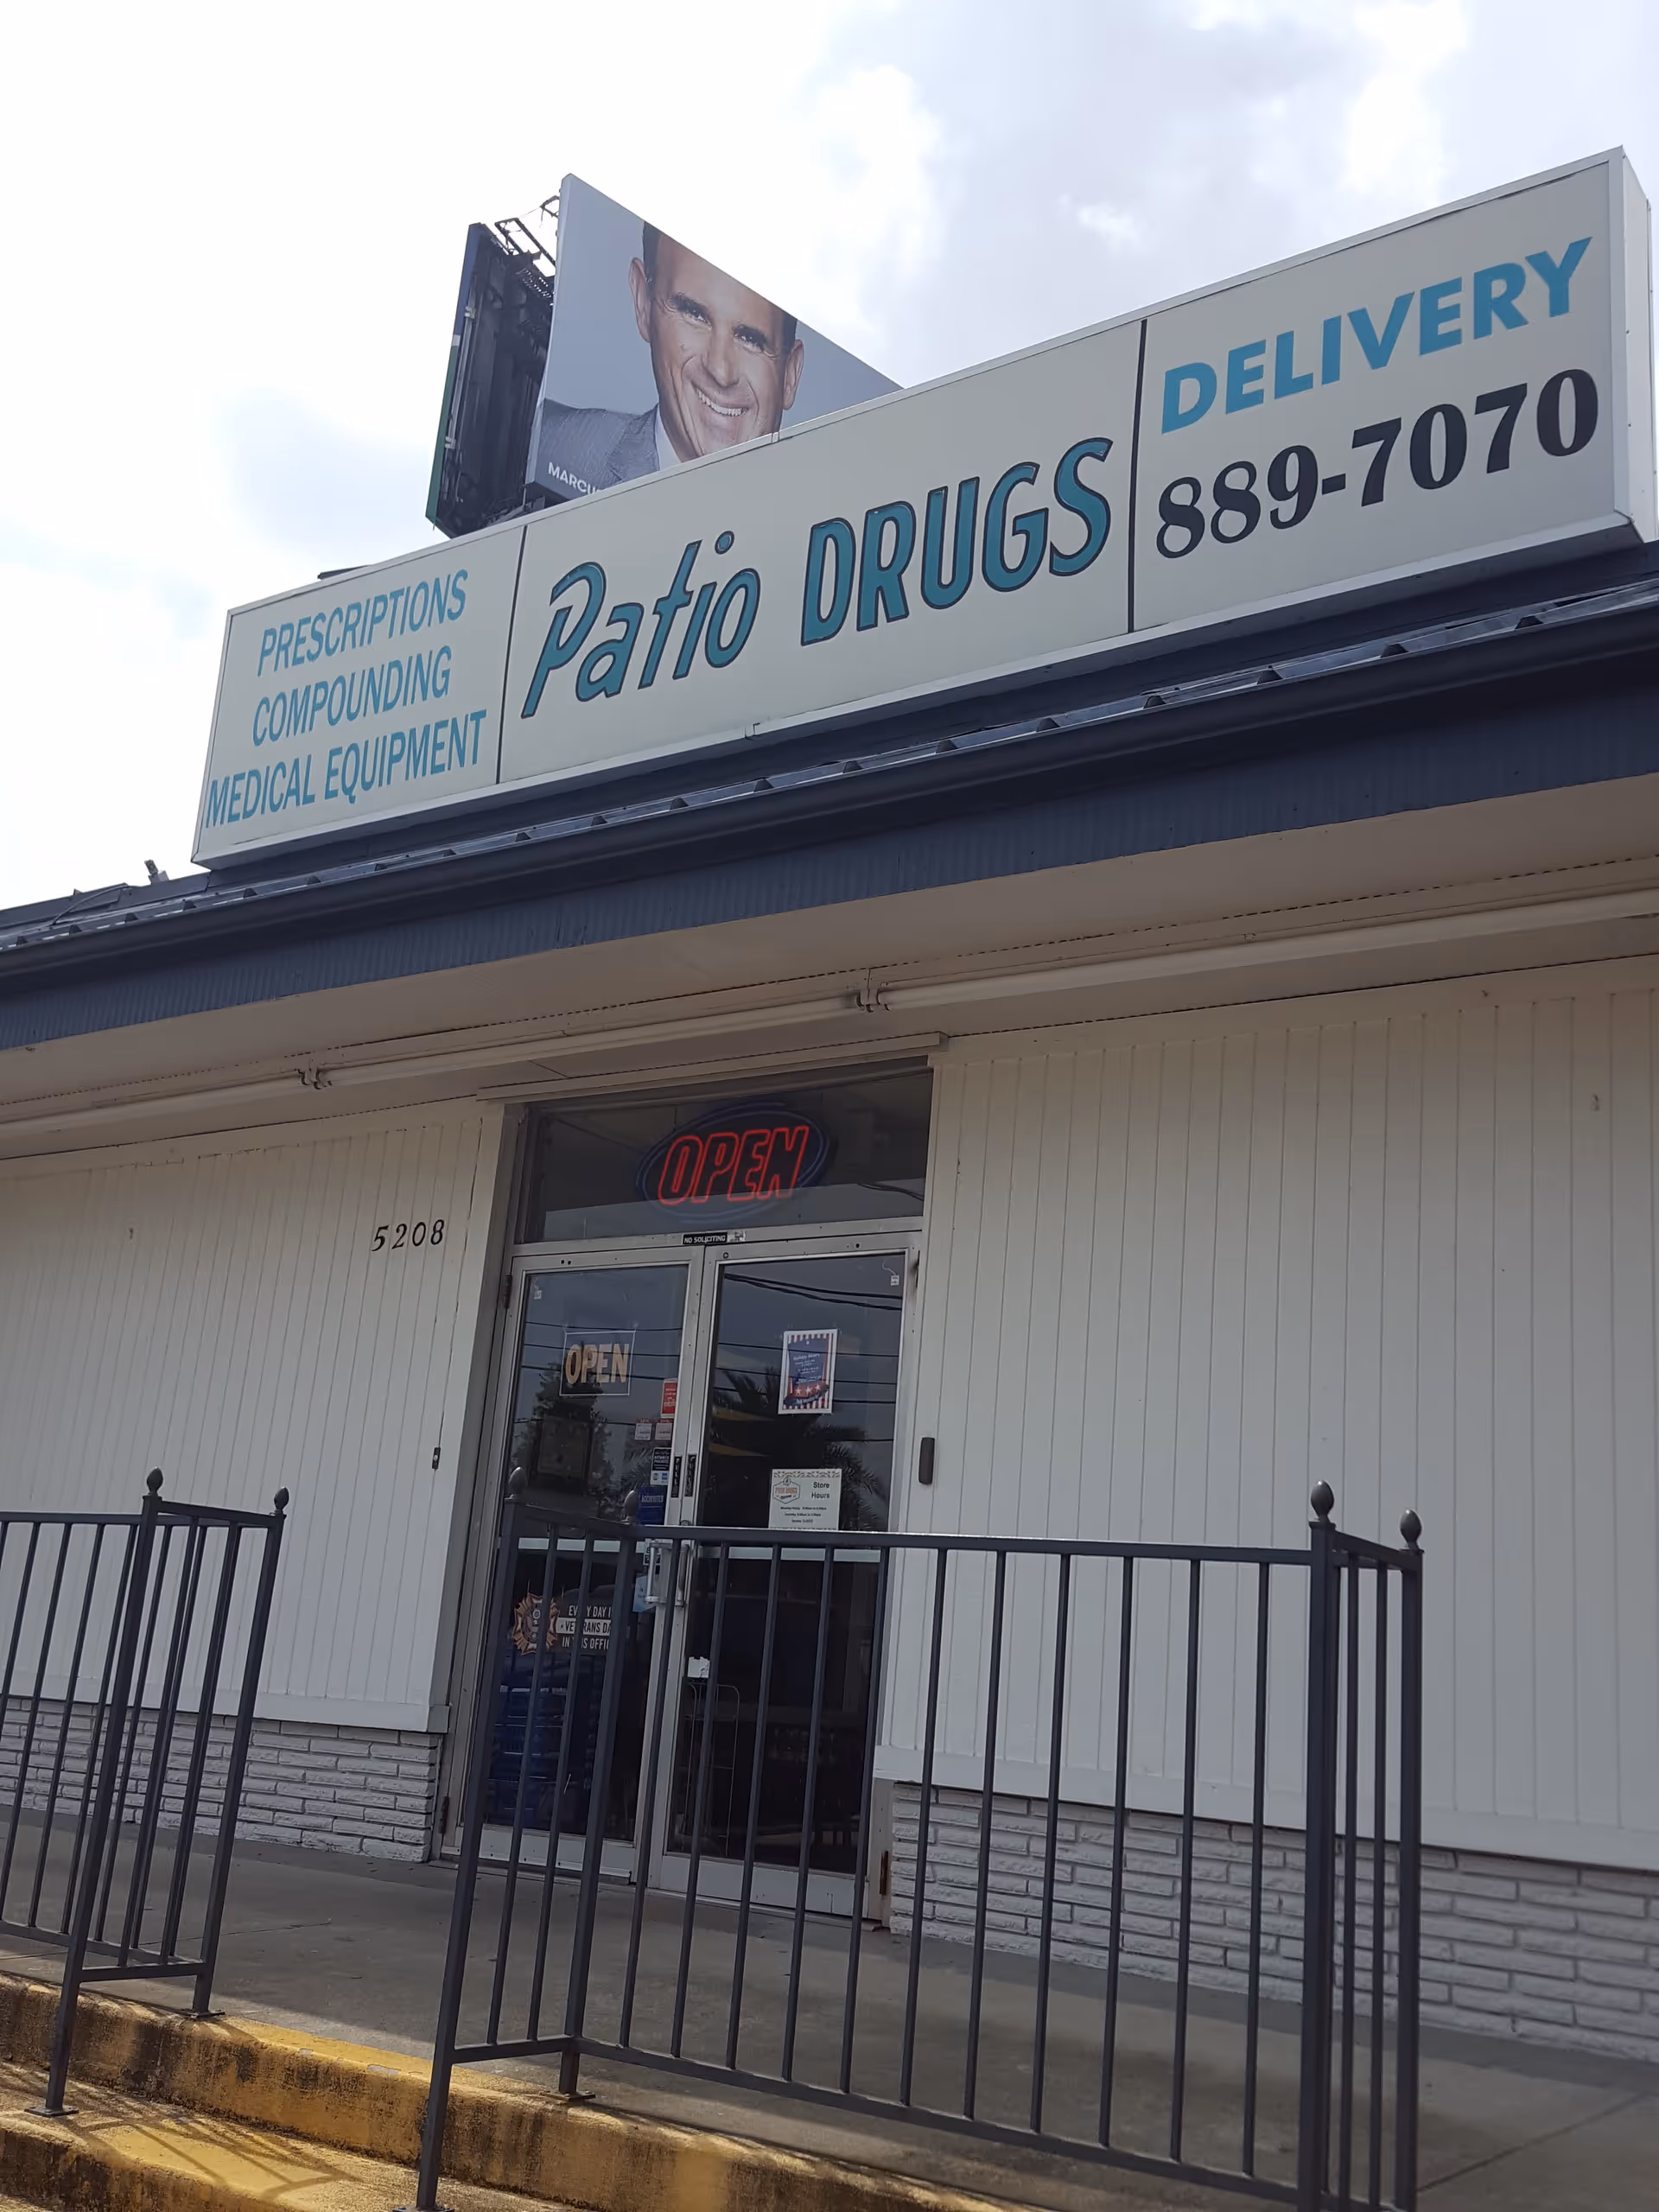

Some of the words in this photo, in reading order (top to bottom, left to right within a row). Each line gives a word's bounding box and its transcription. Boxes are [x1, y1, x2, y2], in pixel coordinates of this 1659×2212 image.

[1161, 236, 1592, 435] DELIVERY
[548, 461, 604, 495] MARCU
[1156, 369, 1599, 559] 889-7070
[521, 531, 761, 719] Patio
[801, 436, 1113, 646] DRUGS
[257, 569, 469, 677] PRESCRIPTIONS
[252, 645, 452, 747] COMPOUNDING
[205, 753, 315, 829] MEDICAL
[324, 709, 486, 804] EQUIPMENT
[658, 1126, 809, 1205] OPEN
[372, 1219, 444, 1251] 5208
[694, 1235, 726, 1243] SOLICITING
[565, 1343, 629, 1384] OPEN
[562, 1637, 570, 1648] IN
[568, 1605, 592, 1617] EVY
[592, 1605, 607, 1618] DAY
